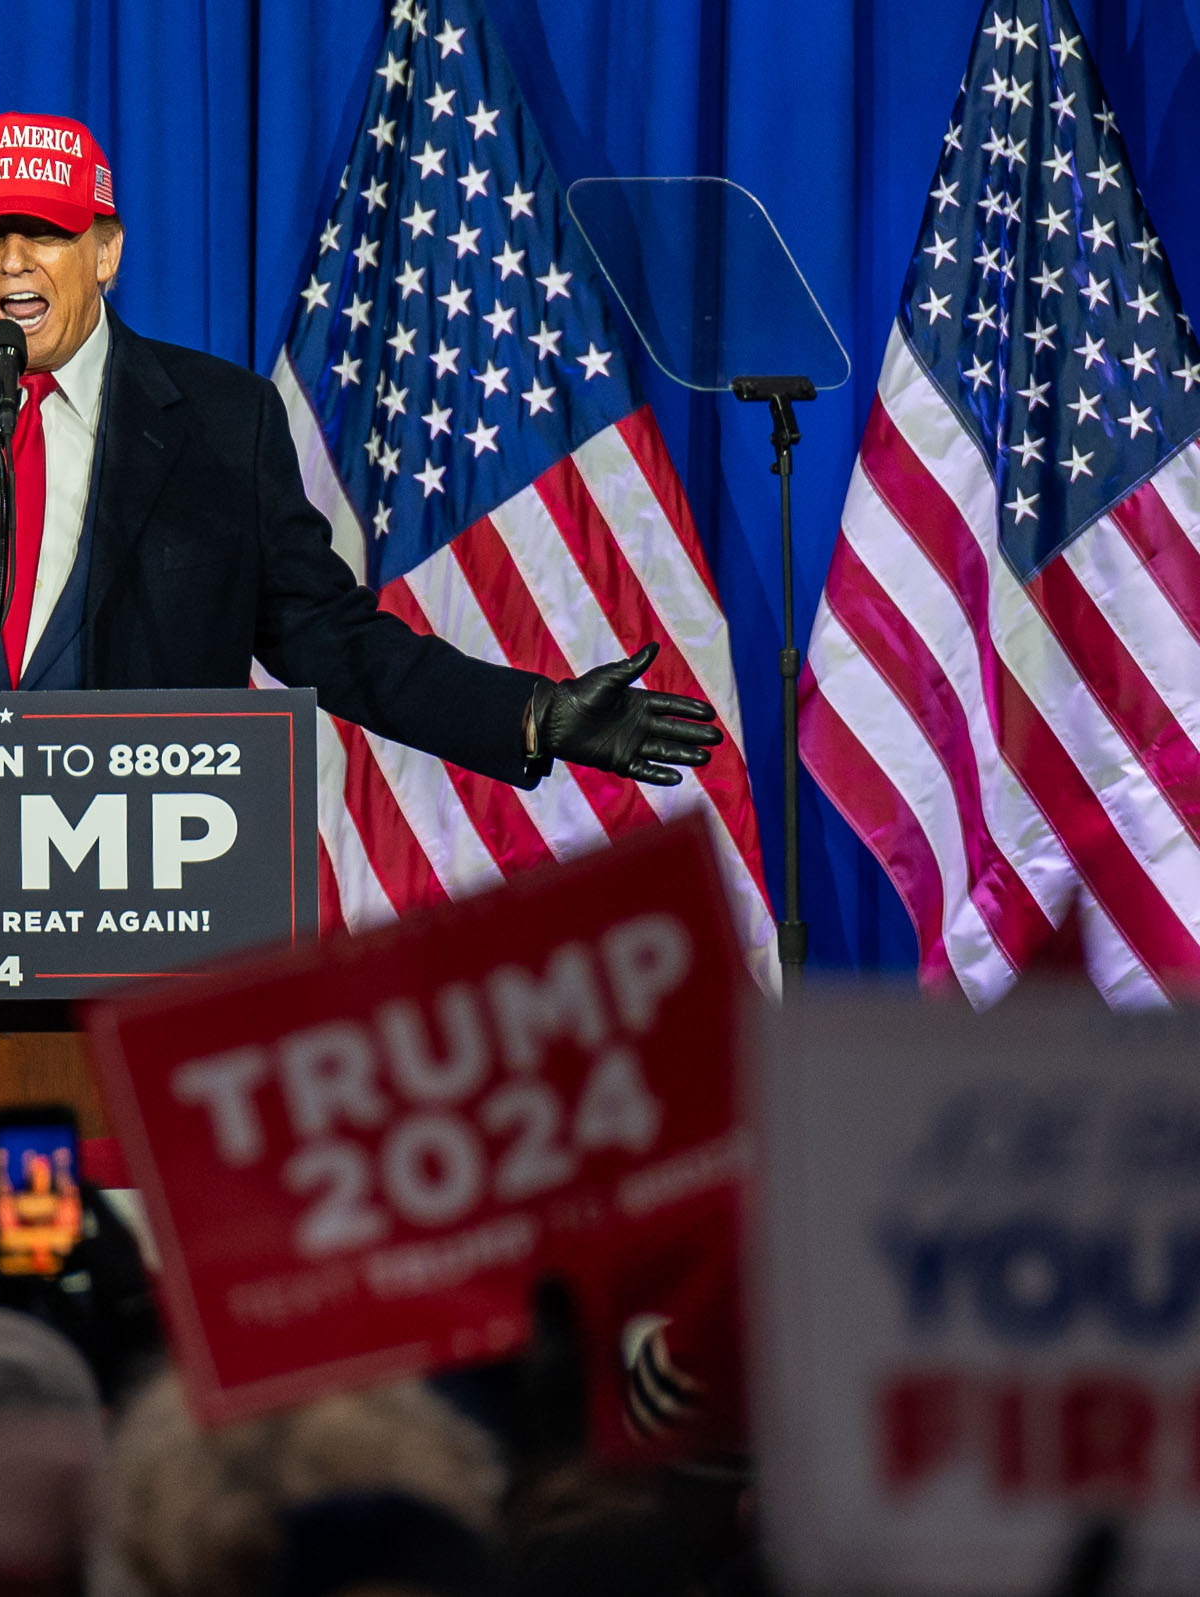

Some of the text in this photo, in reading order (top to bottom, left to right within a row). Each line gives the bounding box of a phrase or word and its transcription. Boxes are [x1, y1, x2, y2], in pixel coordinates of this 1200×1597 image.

[15, 157, 72, 187] AGAIN
[38, 744, 94, 776] TO
[108, 743, 242, 776] 88022
[97, 910, 211, 933] AGAIN!
[170, 912, 694, 1168] TRUMP
[284, 1047, 661, 1258] 2024
